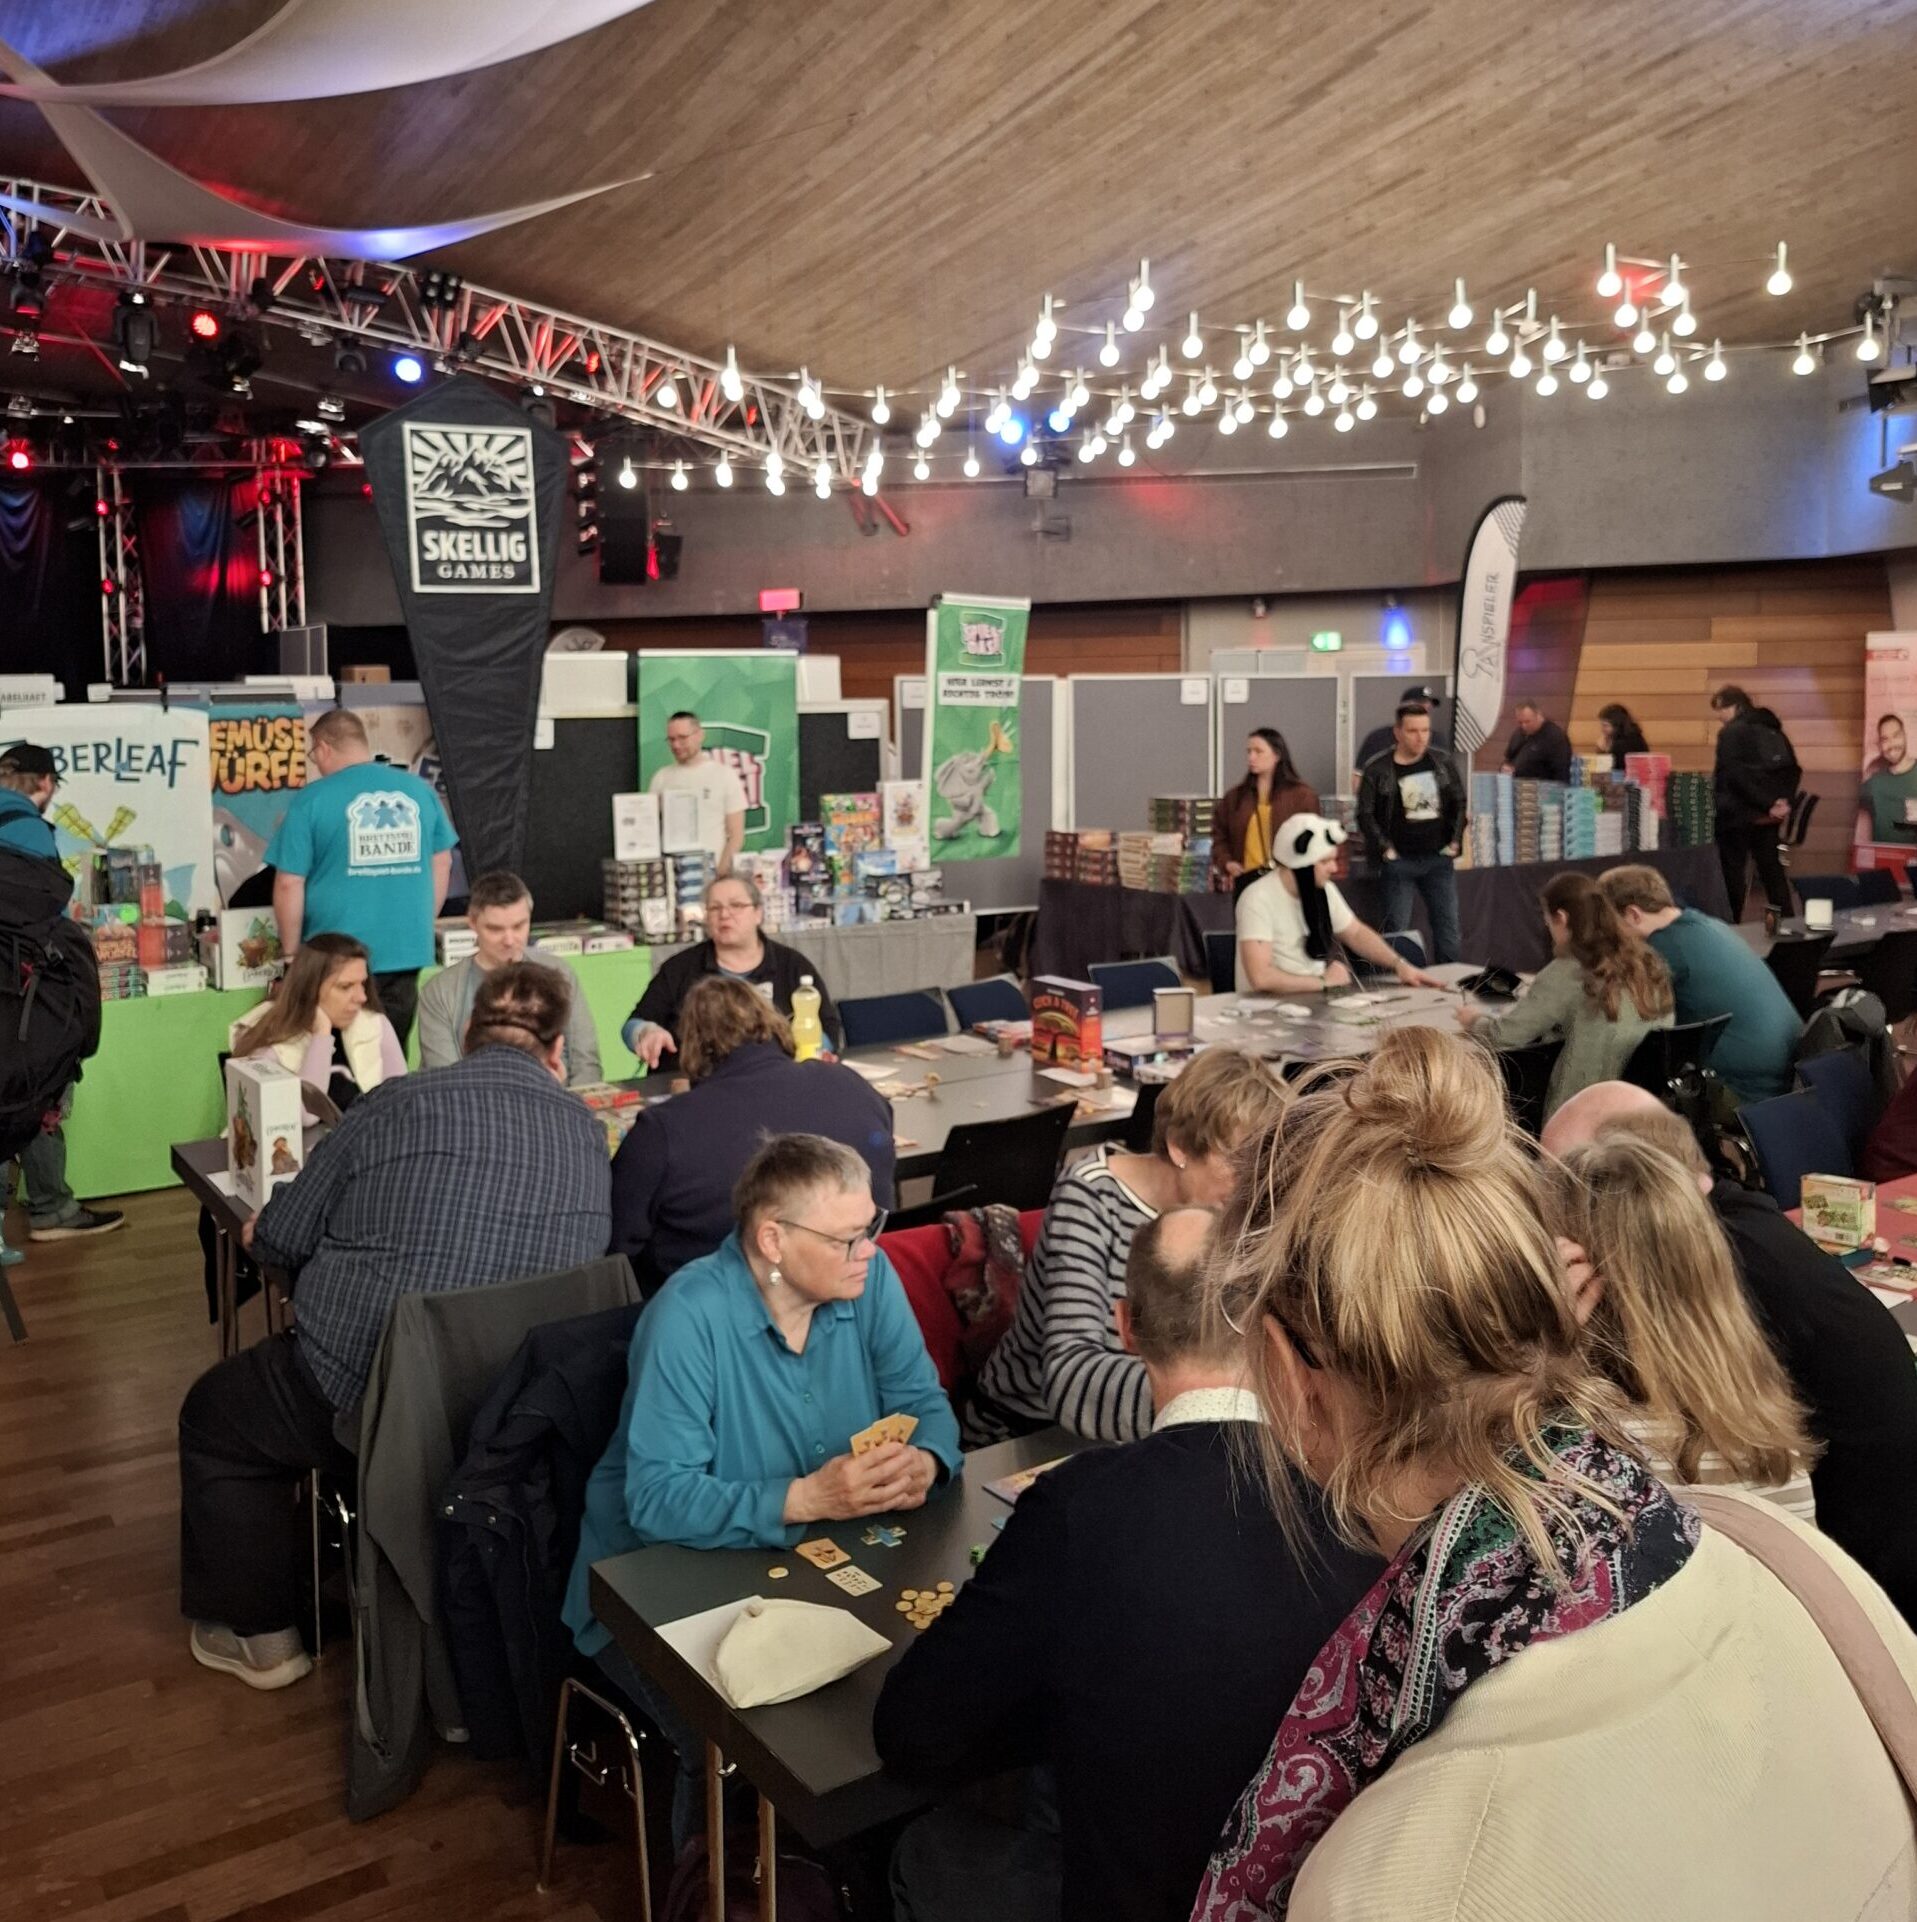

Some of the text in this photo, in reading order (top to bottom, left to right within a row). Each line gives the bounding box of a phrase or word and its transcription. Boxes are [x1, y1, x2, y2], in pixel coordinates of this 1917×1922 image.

[421, 529, 527, 562] SKELLIG
[436, 563, 515, 579] GAMES
[209, 715, 305, 752] EMÜSE
[0, 737, 199, 788] BERLEAF
[360, 841, 416, 857] BANDE
